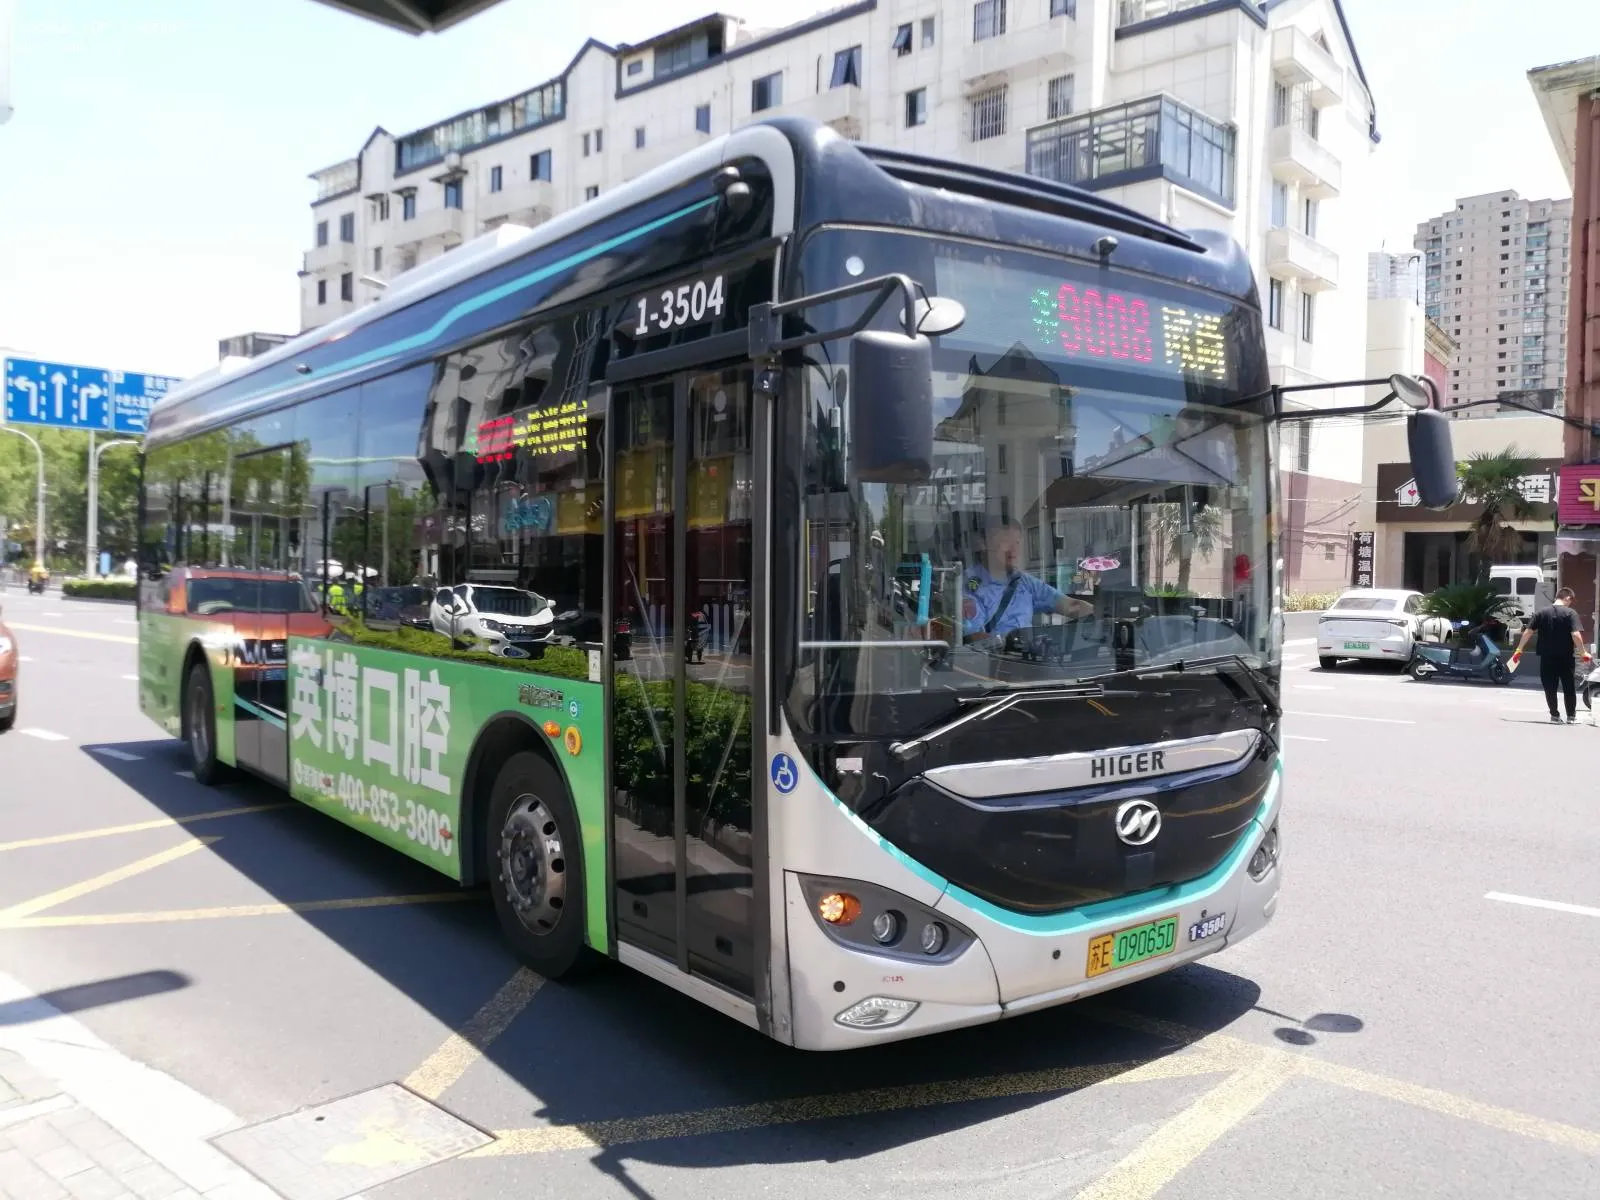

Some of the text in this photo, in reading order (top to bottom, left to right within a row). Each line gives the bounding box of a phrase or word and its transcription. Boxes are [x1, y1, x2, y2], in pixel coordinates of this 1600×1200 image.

[635, 275, 724, 335] 1-3504
[1057, 285, 1151, 361] 9008
[1357, 533, 1372, 586] 荷塘温泉
[291, 643, 451, 796] 英博口腔
[1090, 750, 1164, 778] HIGER
[1118, 922, 1175, 962] 09065D
